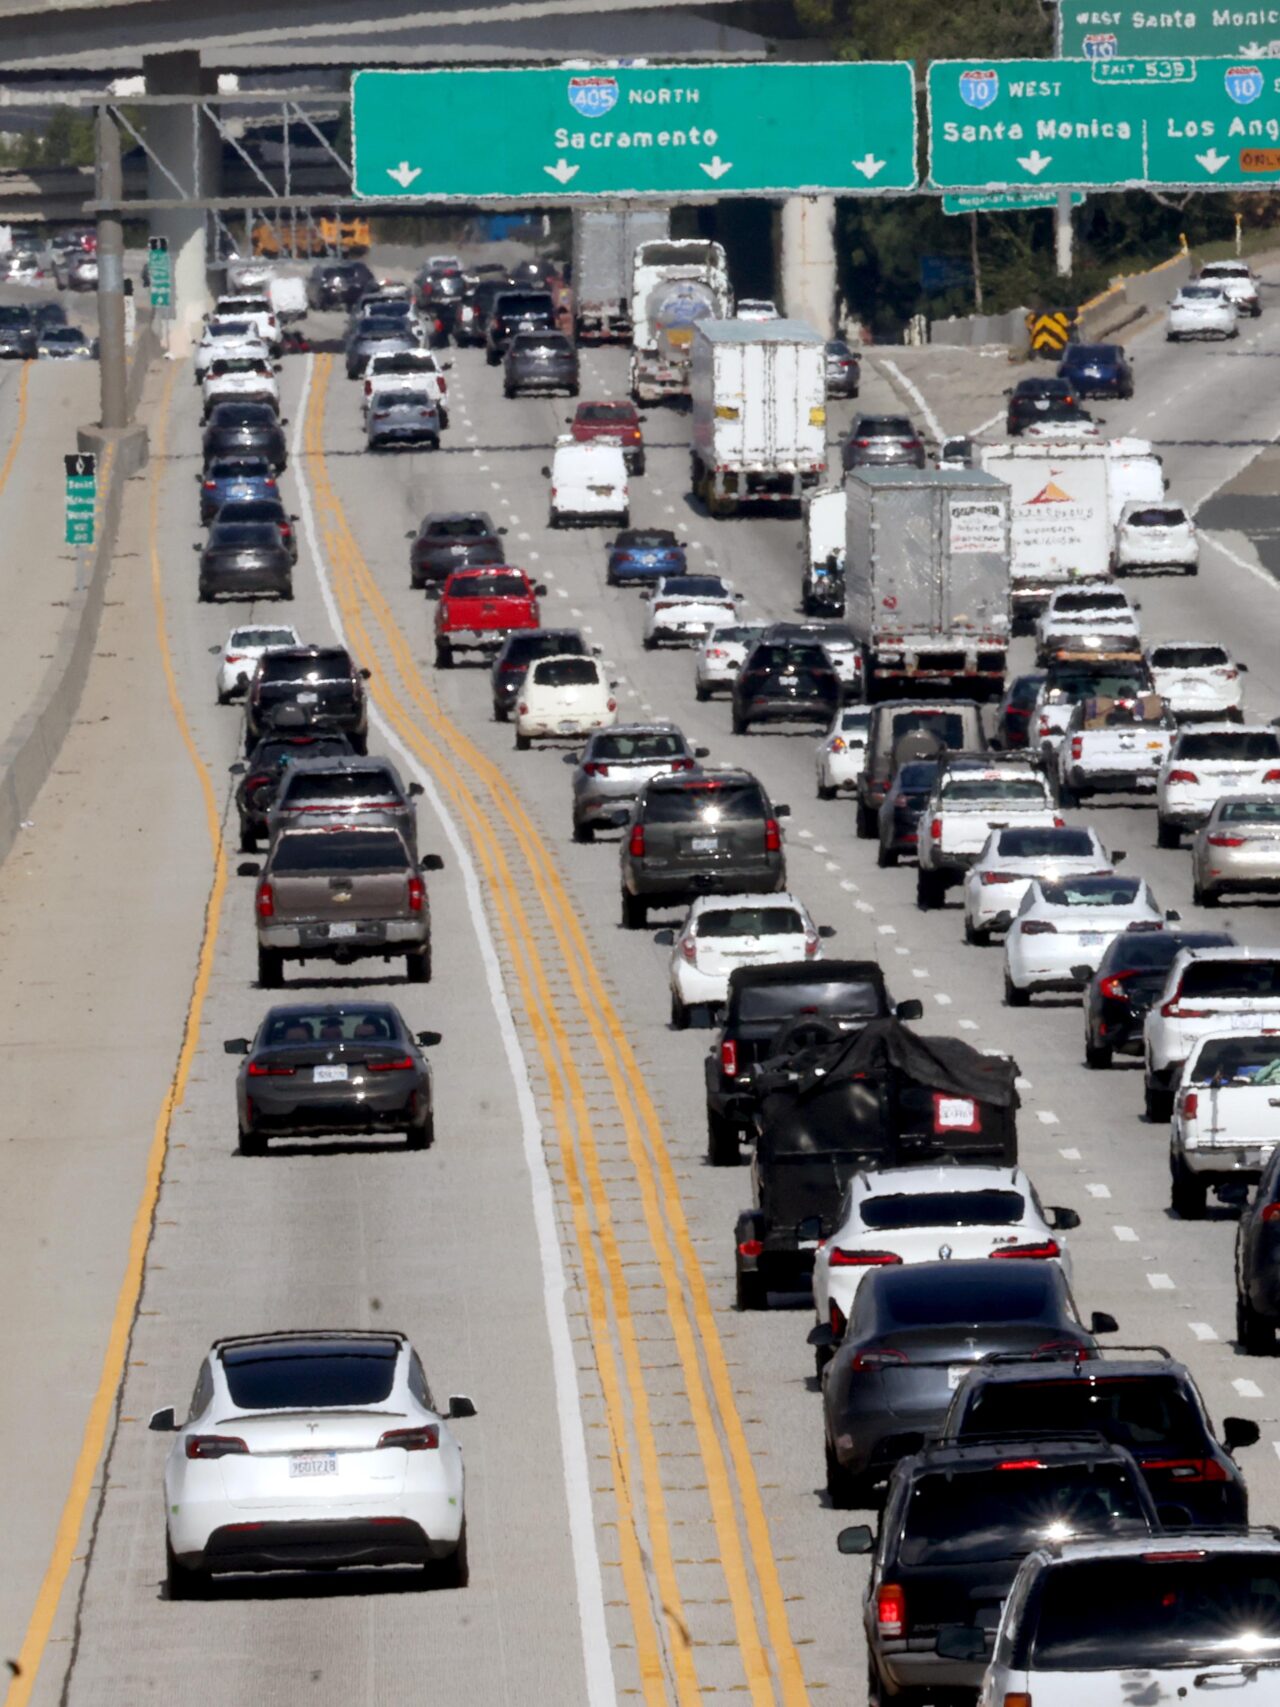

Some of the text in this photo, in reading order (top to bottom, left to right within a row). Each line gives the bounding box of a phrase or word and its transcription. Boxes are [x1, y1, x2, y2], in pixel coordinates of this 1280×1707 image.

[1076, 11, 1121, 25] WEST
[1132, 10, 1196, 28] Santa
[1092, 44, 1113, 57] 10
[1101, 61, 1186, 78] EXIT 53B
[969, 81, 1061, 100] 10 WEST
[1234, 75, 1256, 95] 10
[573, 86, 699, 107] 405 NORTH
[944, 119, 1130, 142] Santa Monica
[1168, 118, 1214, 137] Los
[555, 127, 718, 149] Sacramento
